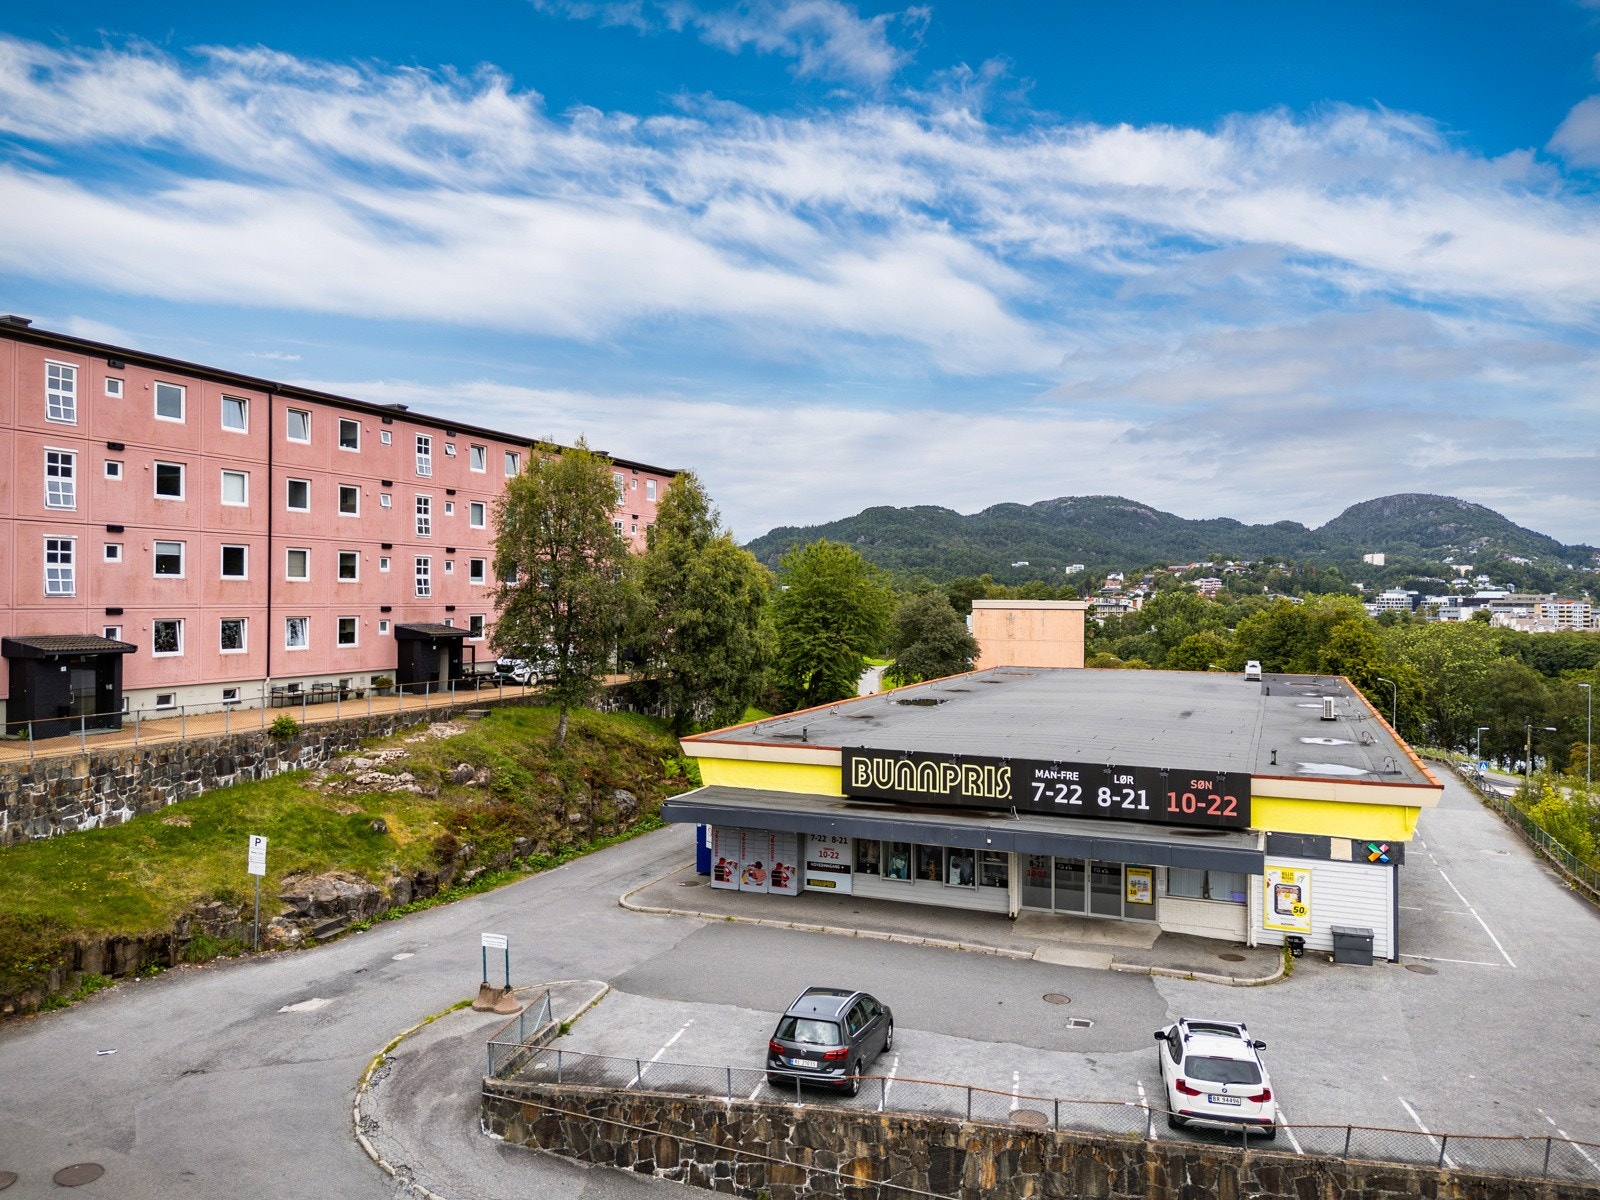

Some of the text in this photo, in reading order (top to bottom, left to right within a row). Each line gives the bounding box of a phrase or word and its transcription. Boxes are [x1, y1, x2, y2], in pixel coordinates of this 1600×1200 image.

[1035, 769, 1079, 781] MAN-FRE
[1114, 775, 1134, 785] LØR
[1190, 779, 1213, 790] SØN
[1031, 782, 1238, 817] 7-22 8-21 10-22
[255, 837, 262, 847] P
[810, 834, 848, 844] 7-22 8-21
[818, 850, 840, 860] 10-22
